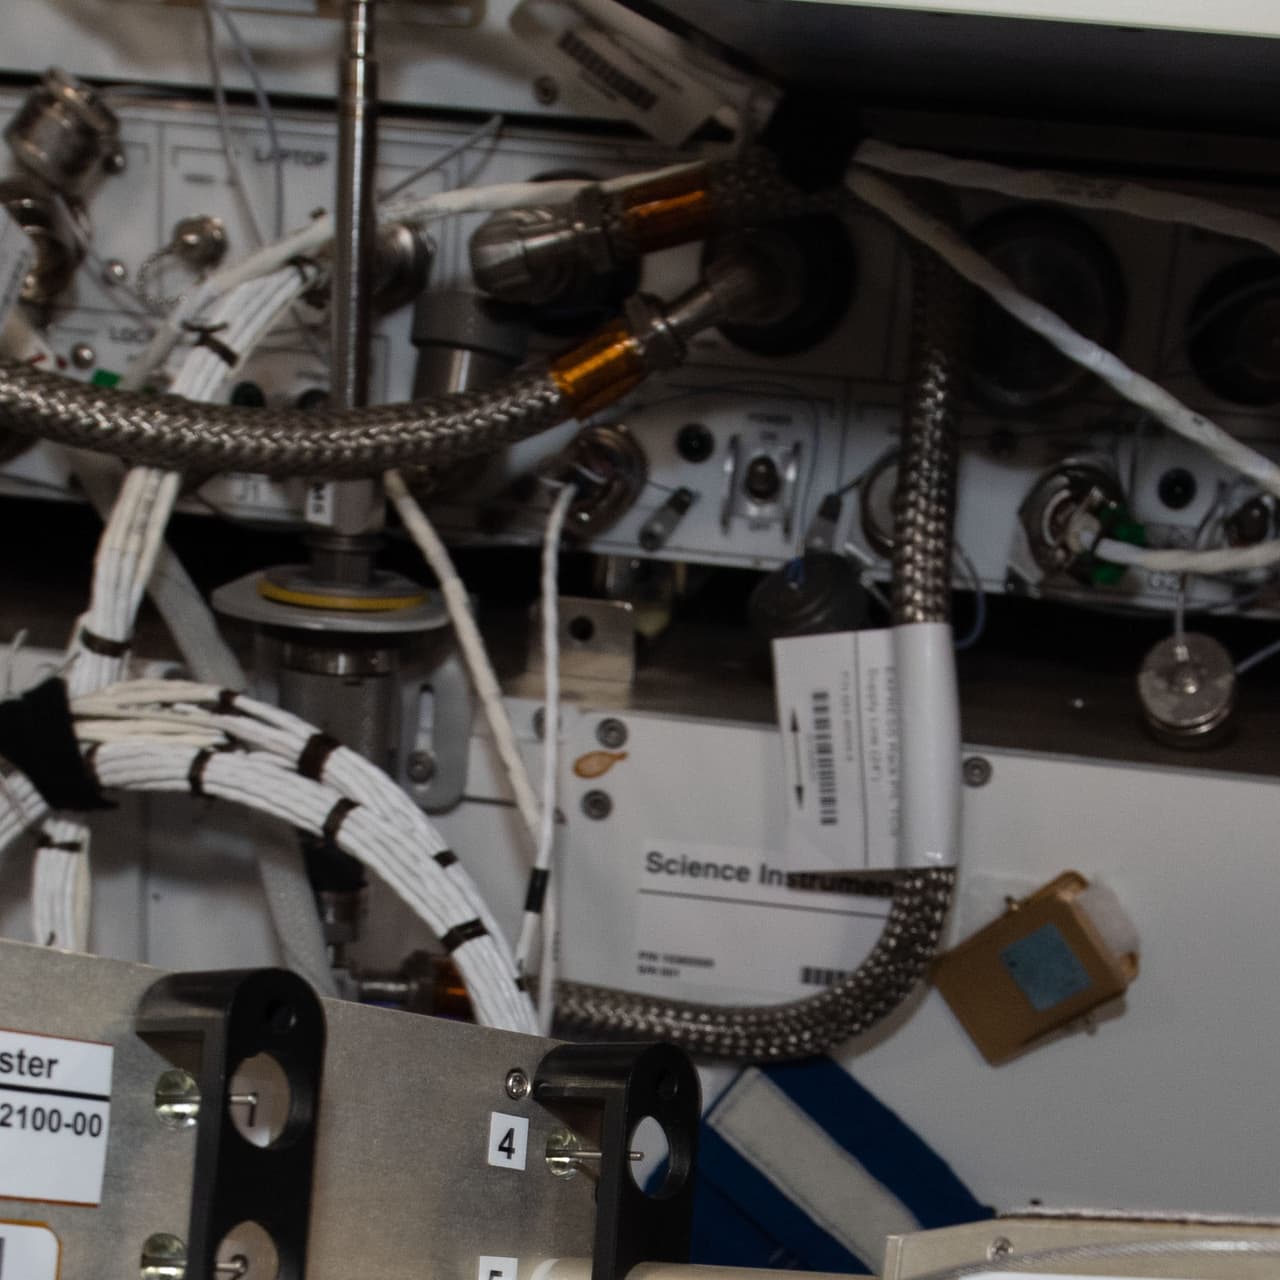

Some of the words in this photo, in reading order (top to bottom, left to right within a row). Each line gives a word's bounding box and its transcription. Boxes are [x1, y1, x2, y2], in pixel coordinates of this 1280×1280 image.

[645, 850, 750, 883] Science
[758, 863, 896, 899] Instrumen
[498, 1127, 516, 1160] 4
